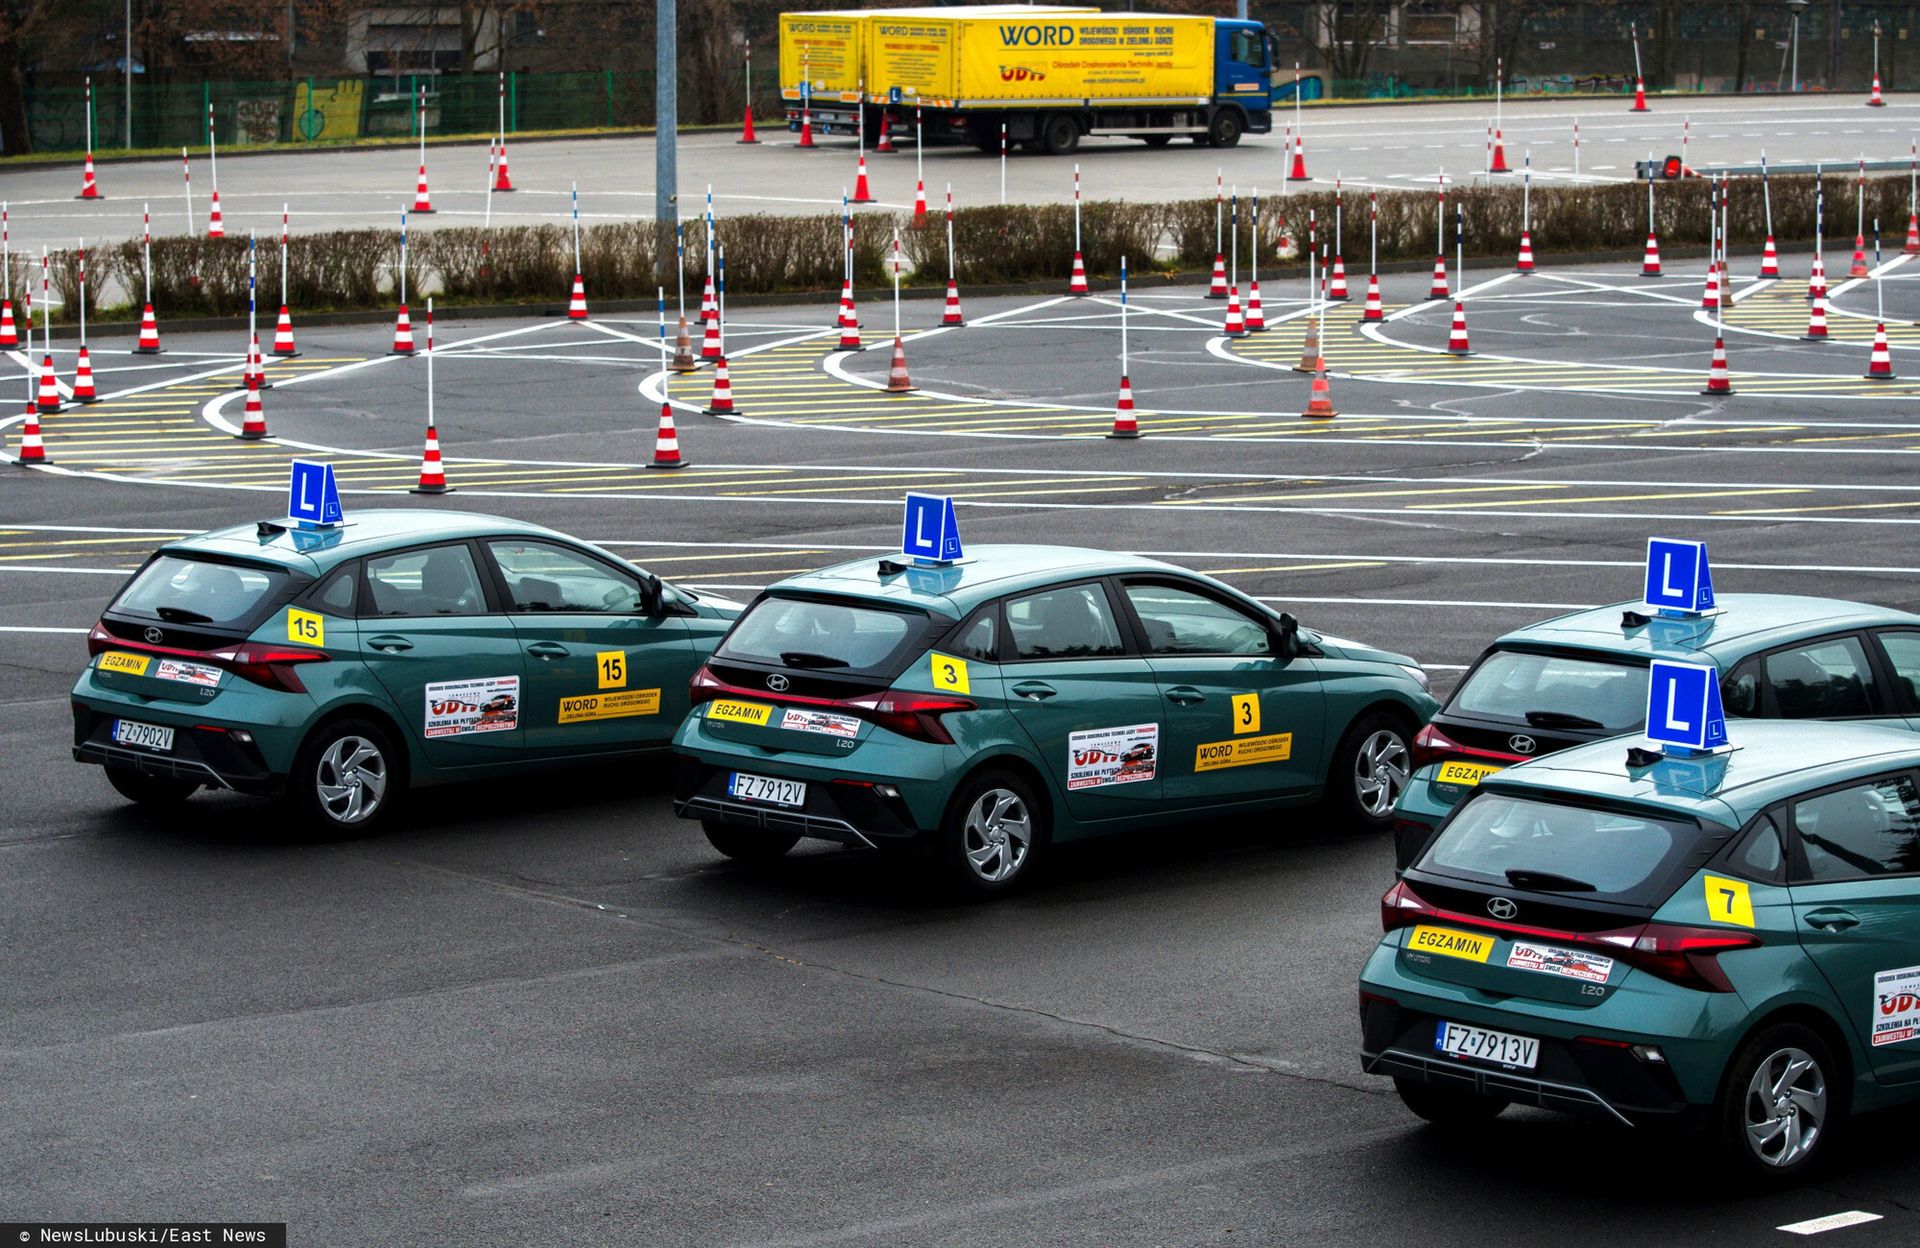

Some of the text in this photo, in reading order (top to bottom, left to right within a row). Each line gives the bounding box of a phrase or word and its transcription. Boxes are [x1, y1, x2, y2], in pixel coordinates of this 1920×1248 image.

[788, 23, 815, 33] WORD
[879, 26, 908, 37] WORD
[999, 26, 1075, 46] WORD
[300, 472, 315, 512] L
[329, 505, 336, 515] L
[916, 506, 933, 548] L
[948, 541, 956, 551] L
[1662, 552, 1684, 597] L
[1702, 590, 1709, 602] L
[294, 617, 318, 639] 15
[104, 655, 143, 670] EGZAMIN
[602, 658, 622, 681] 15
[944, 663, 958, 685] 3
[562, 698, 598, 713] WORD
[714, 704, 763, 720] EGZAMIN
[1241, 702, 1252, 725] 3
[1666, 678, 1690, 731] L
[135, 724, 172, 748] 7902V
[1712, 723, 1719, 736] L
[1199, 744, 1233, 760] WORD
[736, 775, 802, 804] FZ 7912V
[1719, 888, 1736, 914] 7
[1418, 931, 1482, 954] EGZAMIN
[1446, 1026, 1535, 1065] FZ 7913V
